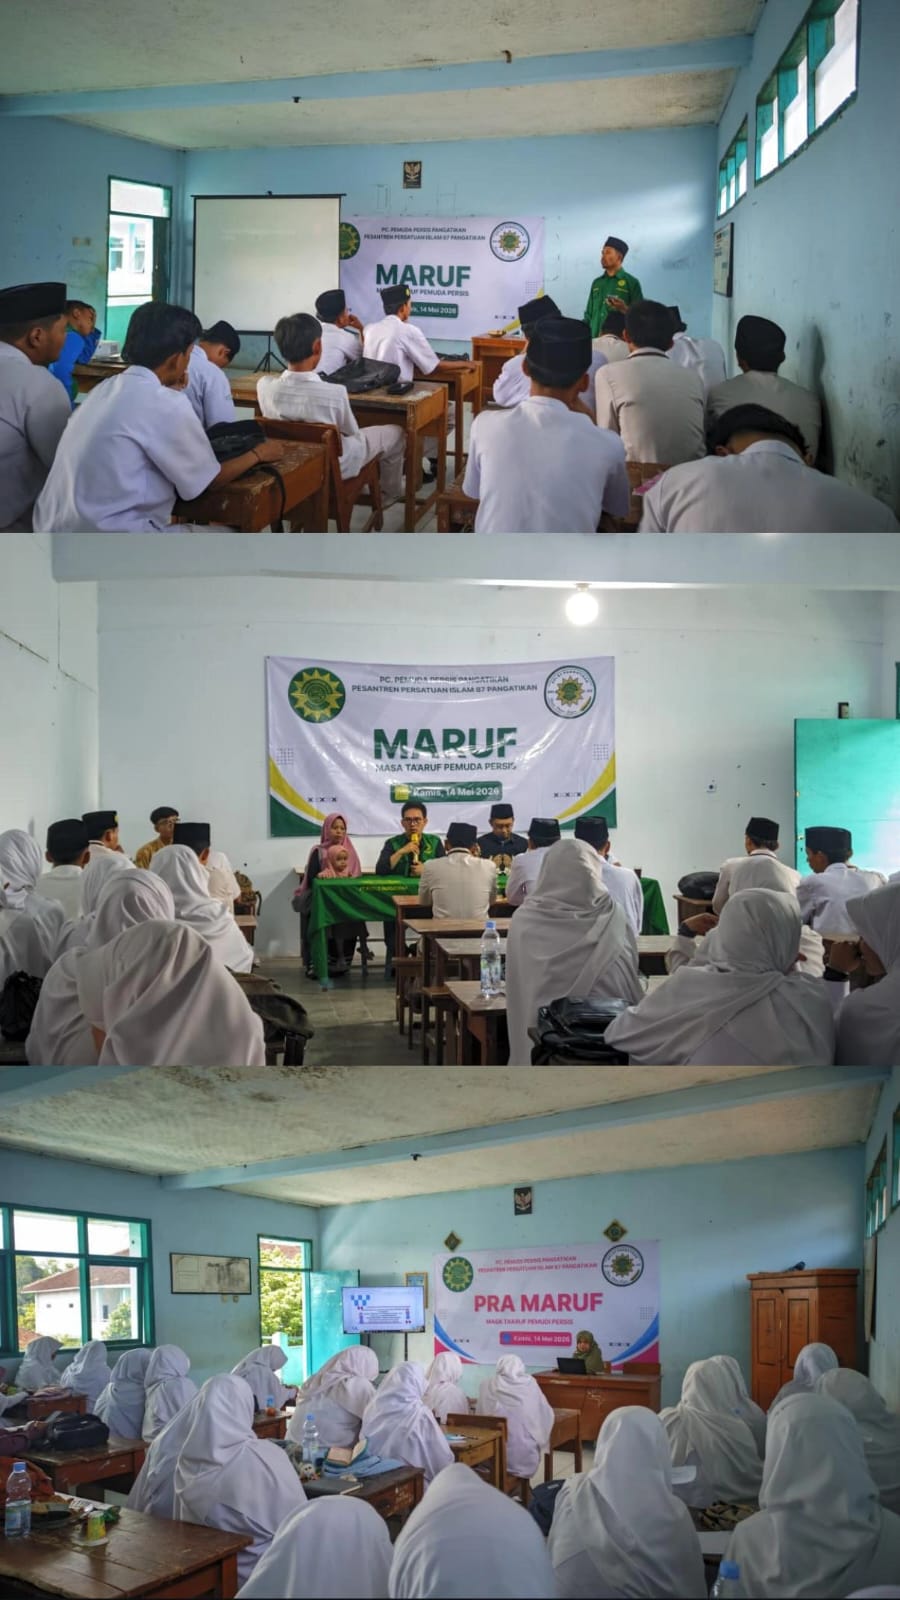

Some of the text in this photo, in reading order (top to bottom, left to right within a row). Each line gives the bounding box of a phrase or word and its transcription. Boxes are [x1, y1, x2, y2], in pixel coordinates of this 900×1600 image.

[376, 264, 471, 288] MARUF
[420, 288, 446, 296] PEMUDA
[374, 728, 517, 760] MARUF
[376, 764, 404, 772] MASA
[444, 762, 482, 772] PEMUDA
[484, 762, 517, 770] PERSIS
[413, 788, 444, 798] Kamis,
[446, 788, 456, 796] 14
[457, 787, 475, 796] Mei
[474, 1292, 604, 1312] PRA MARUF
